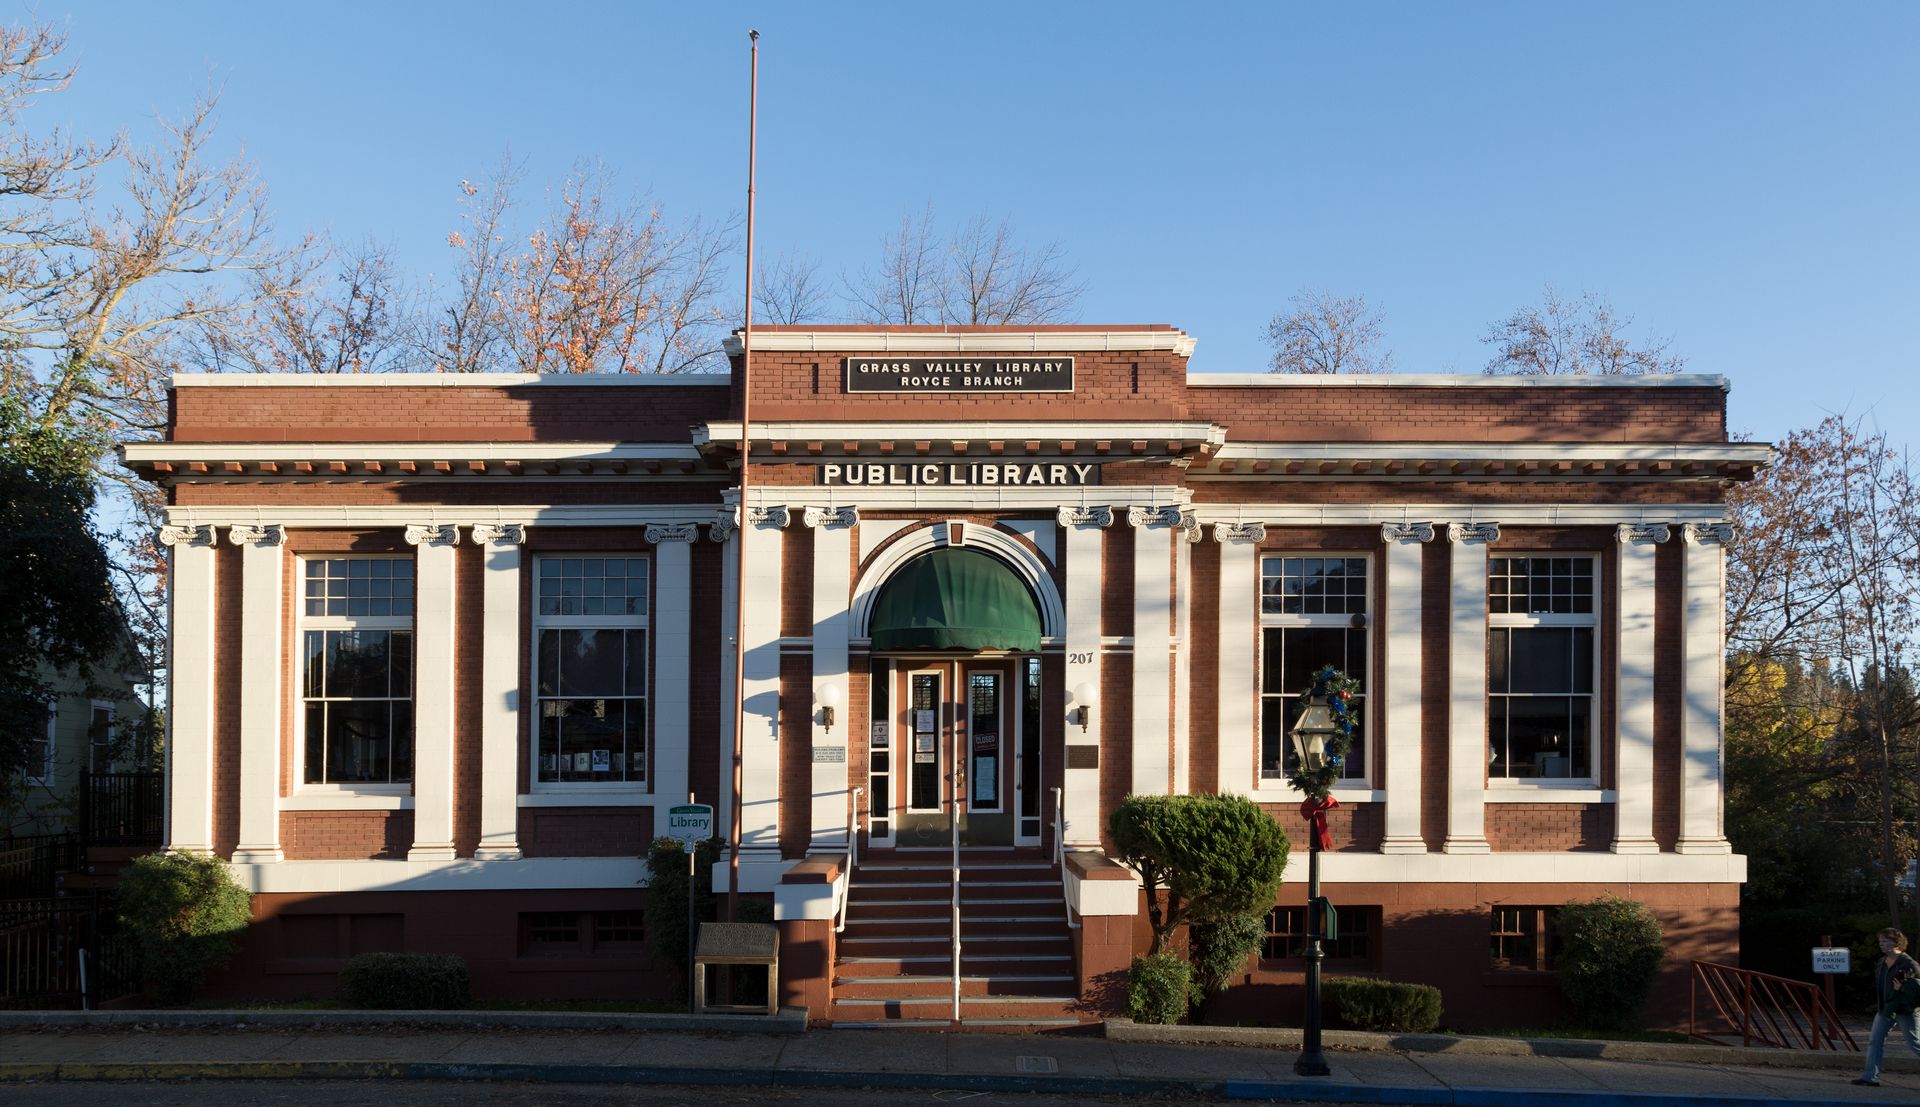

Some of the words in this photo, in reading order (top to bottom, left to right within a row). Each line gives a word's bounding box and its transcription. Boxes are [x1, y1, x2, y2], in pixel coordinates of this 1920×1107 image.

[860, 363, 911, 373] GRASS
[926, 363, 982, 373] VALLEY
[996, 363, 1063, 373] LIBRARY
[901, 376, 950, 386] ROYCE
[963, 376, 1023, 386] BRANCH
[824, 464, 940, 485] PUBLIC
[950, 464, 1092, 485] LIBRARY
[1069, 652, 1094, 664] 207
[975, 735, 996, 745] CLOSED
[670, 816, 710, 830] Library
